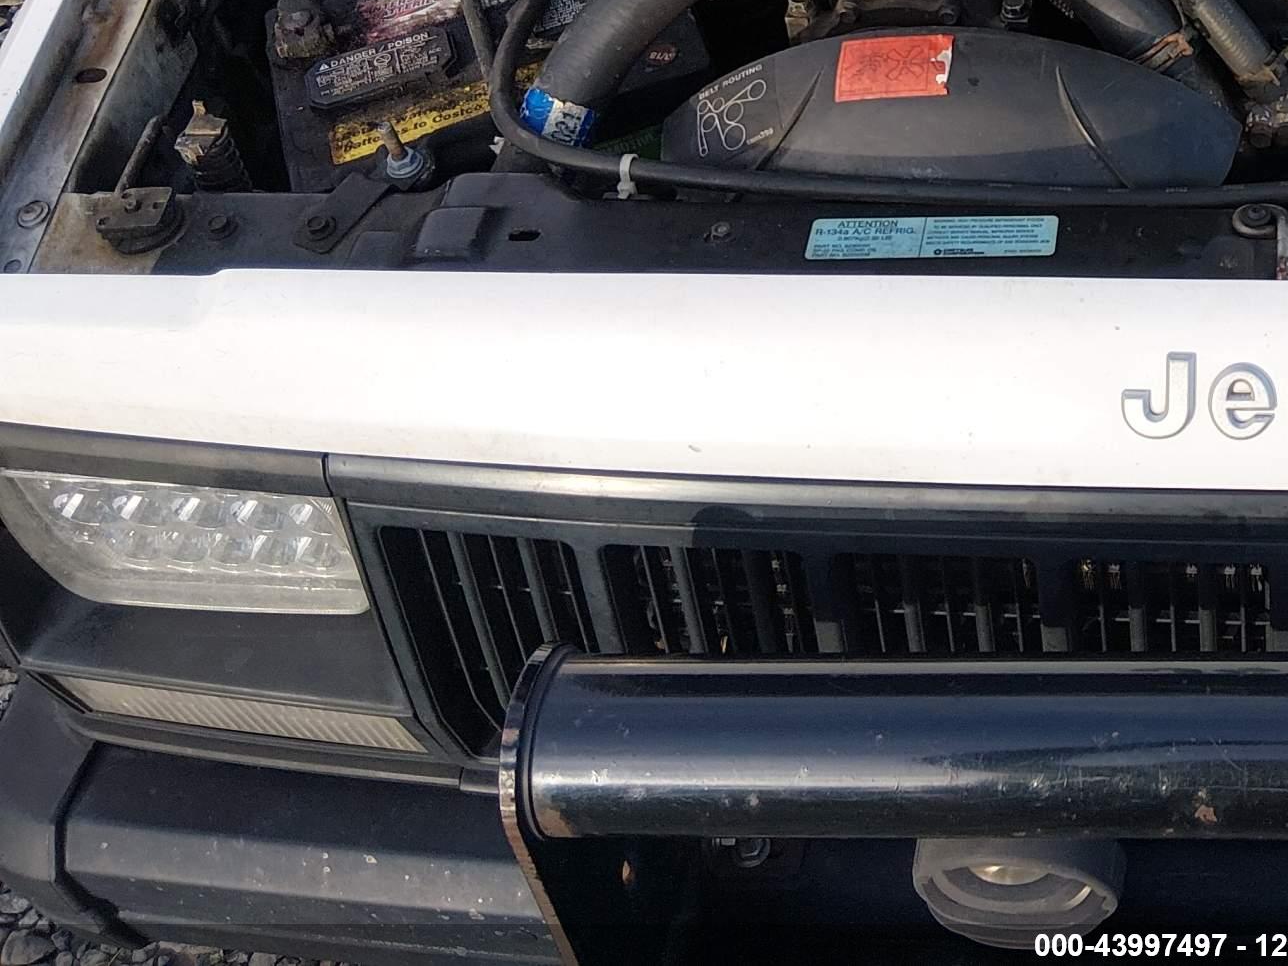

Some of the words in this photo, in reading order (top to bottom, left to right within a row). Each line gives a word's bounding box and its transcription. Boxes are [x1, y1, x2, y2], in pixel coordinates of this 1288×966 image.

[330, 49, 377, 67] DANGER
[388, 32, 429, 50] POISON
[699, 84, 719, 100] BELT
[722, 64, 762, 88] ROUTING
[838, 220, 898, 228] ATTENTION
